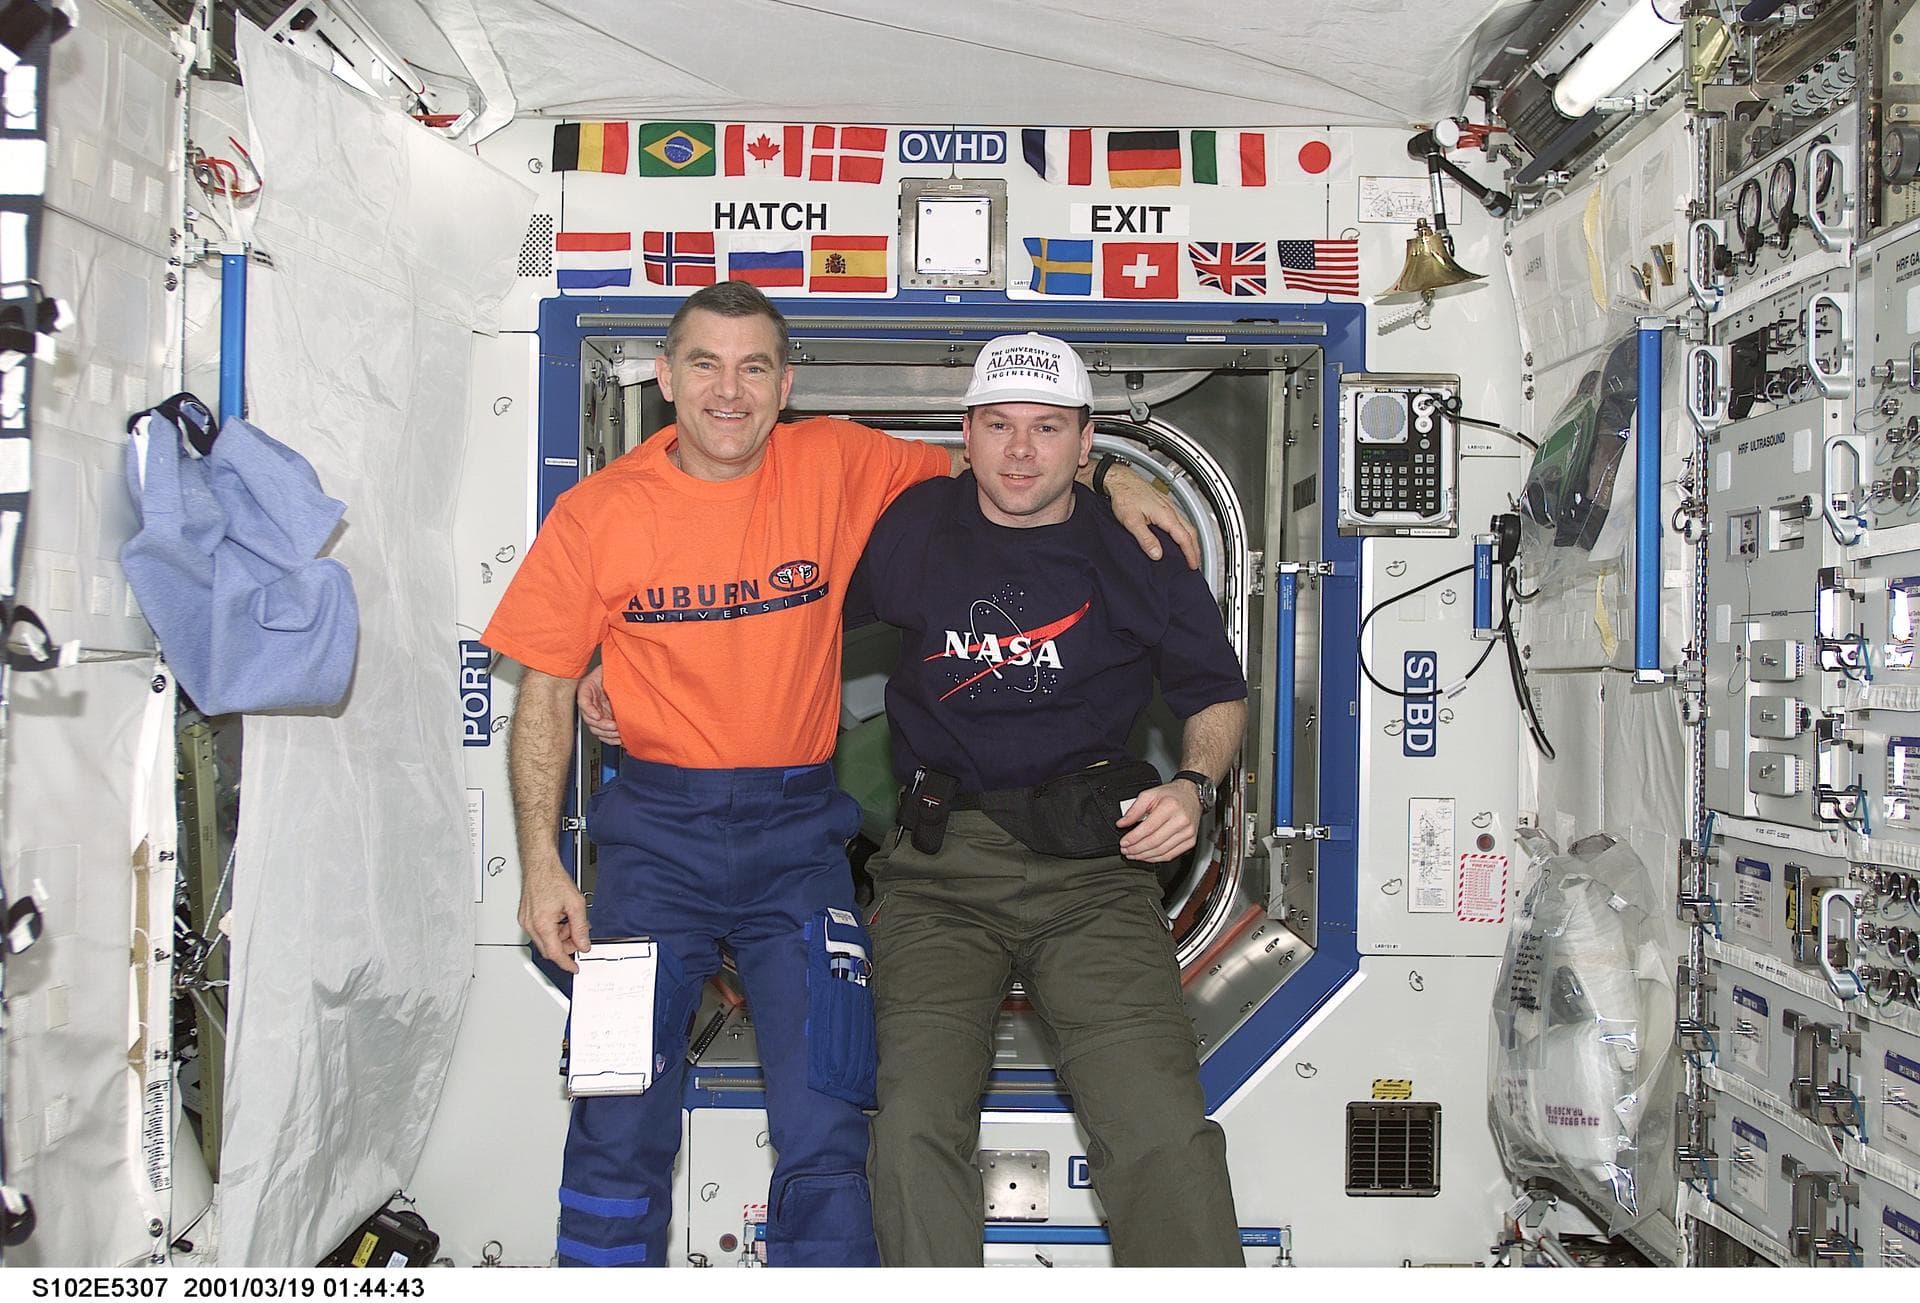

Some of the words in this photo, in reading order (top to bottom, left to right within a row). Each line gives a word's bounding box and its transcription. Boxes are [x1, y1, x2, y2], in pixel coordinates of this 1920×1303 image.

[902, 133, 1005, 162] OVHD
[714, 202, 828, 230] HATCH
[1091, 205, 1171, 233] EXIT
[986, 354, 1060, 373] ALABAMA
[991, 350, 1004, 358] THE
[1005, 346, 1050, 357] UNIVERSITY
[987, 370, 1058, 384] ENGINEERING
[1750, 432, 1786, 452] ULTRASOUND
[628, 579, 760, 611] AUBURN
[634, 589, 825, 621] UNIVERSITY
[942, 630, 1064, 669] NASA
[461, 644, 489, 741] PORT
[1406, 656, 1434, 752] STBD
